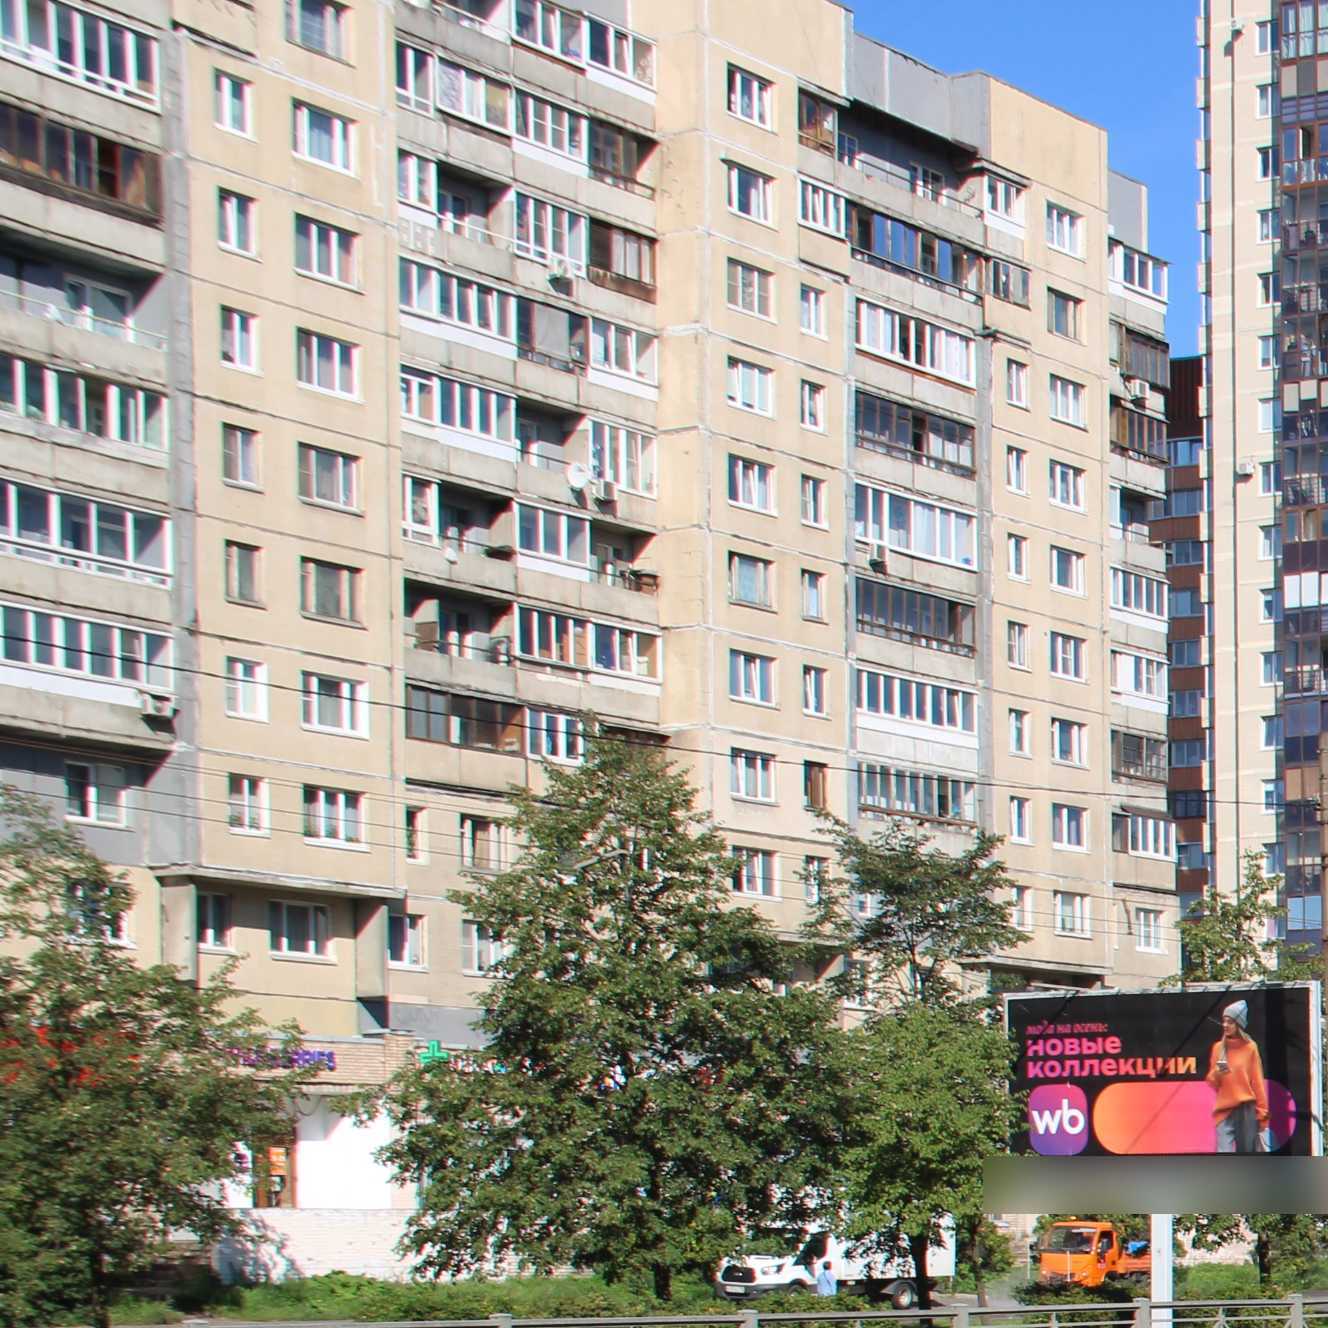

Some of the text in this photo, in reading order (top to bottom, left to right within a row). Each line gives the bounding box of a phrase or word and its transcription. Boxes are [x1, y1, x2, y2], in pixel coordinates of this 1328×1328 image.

[1026, 1035, 1122, 1057] новые
[1027, 1056, 1197, 1079] коллекции
[1032, 1098, 1086, 1135] wb
